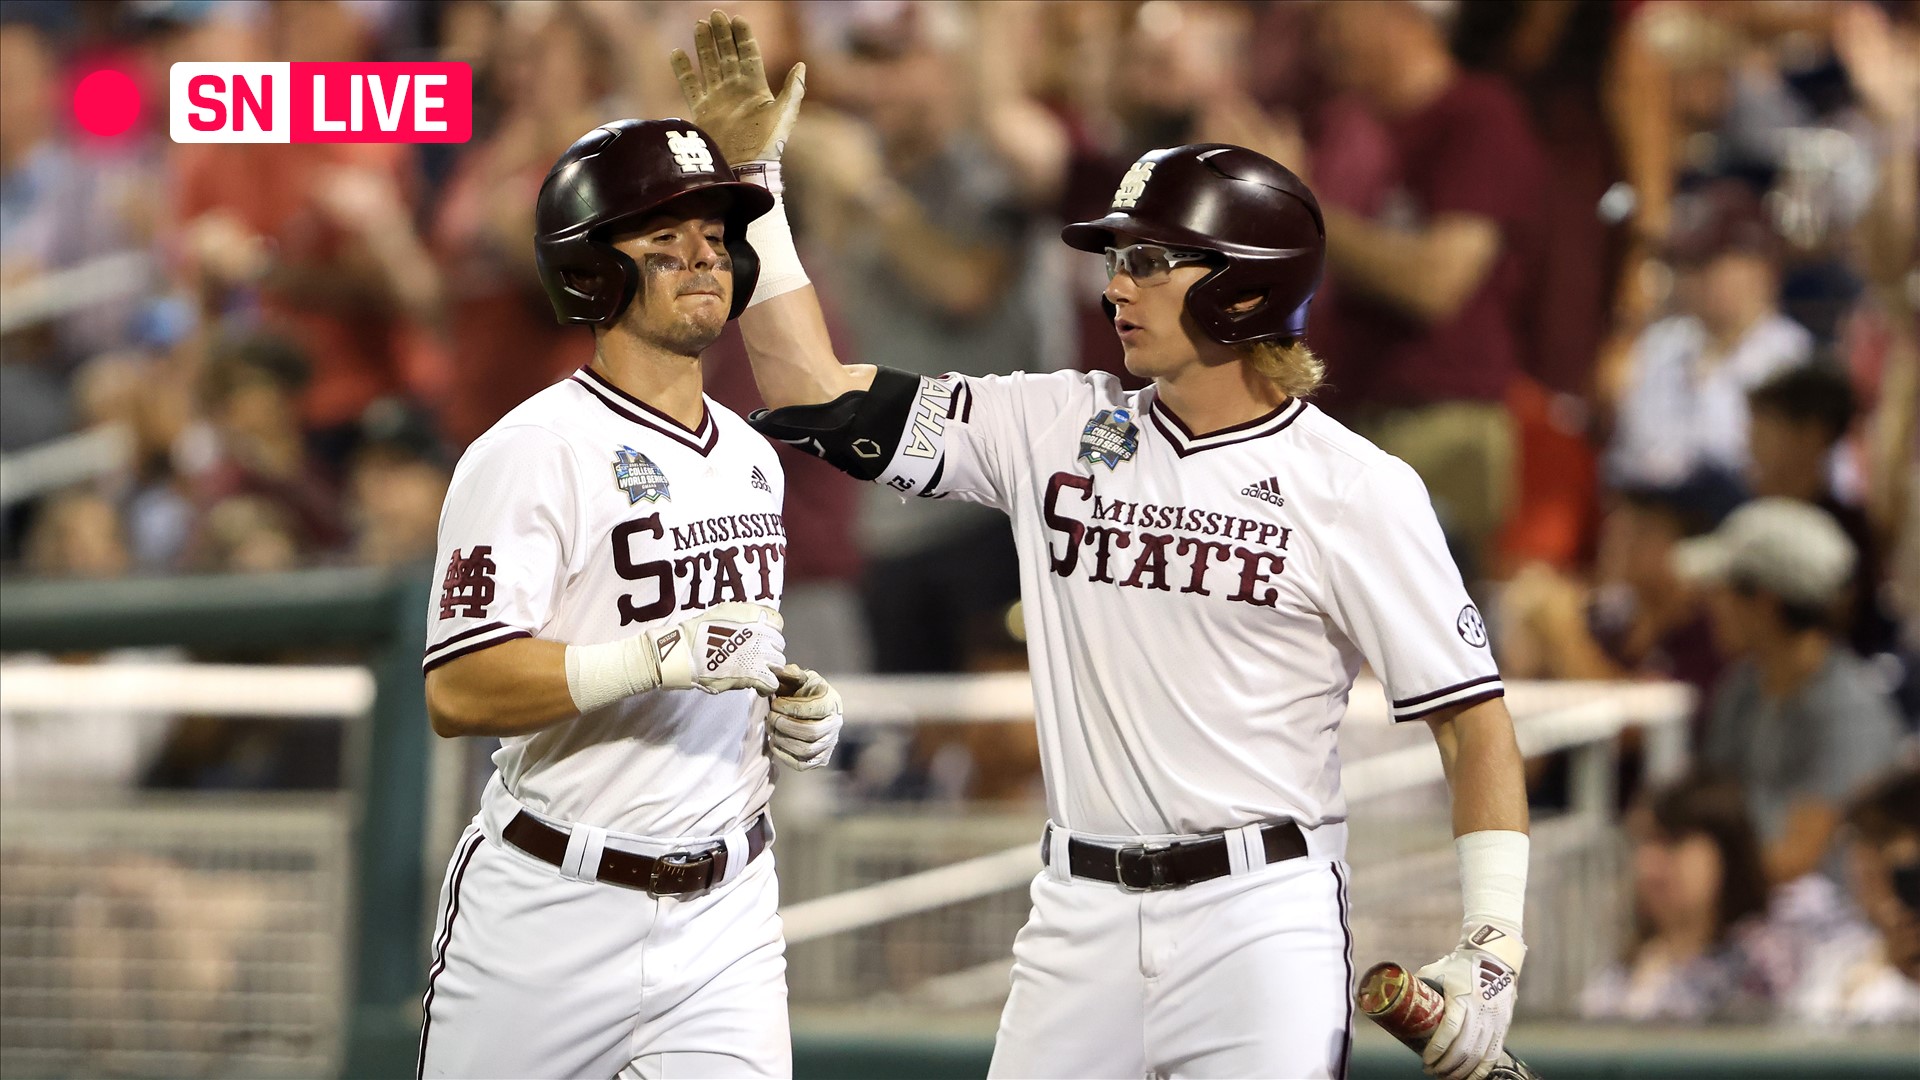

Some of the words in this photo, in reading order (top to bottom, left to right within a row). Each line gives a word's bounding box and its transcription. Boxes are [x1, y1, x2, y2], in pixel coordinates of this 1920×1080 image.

[1092, 427, 1126, 446] COLLEGE
[1101, 440, 1132, 460] SERIES
[620, 476, 647, 489] WORLD
[629, 467, 656, 477] COLLEGE
[1241, 487, 1285, 507] adidas
[1091, 495, 1293, 551] MISSISSIPPI
[1044, 471, 1287, 608] STATE
[611, 512, 787, 626] STAT
[706, 628, 753, 672] adidas
[1482, 973, 1512, 1001] adidas
